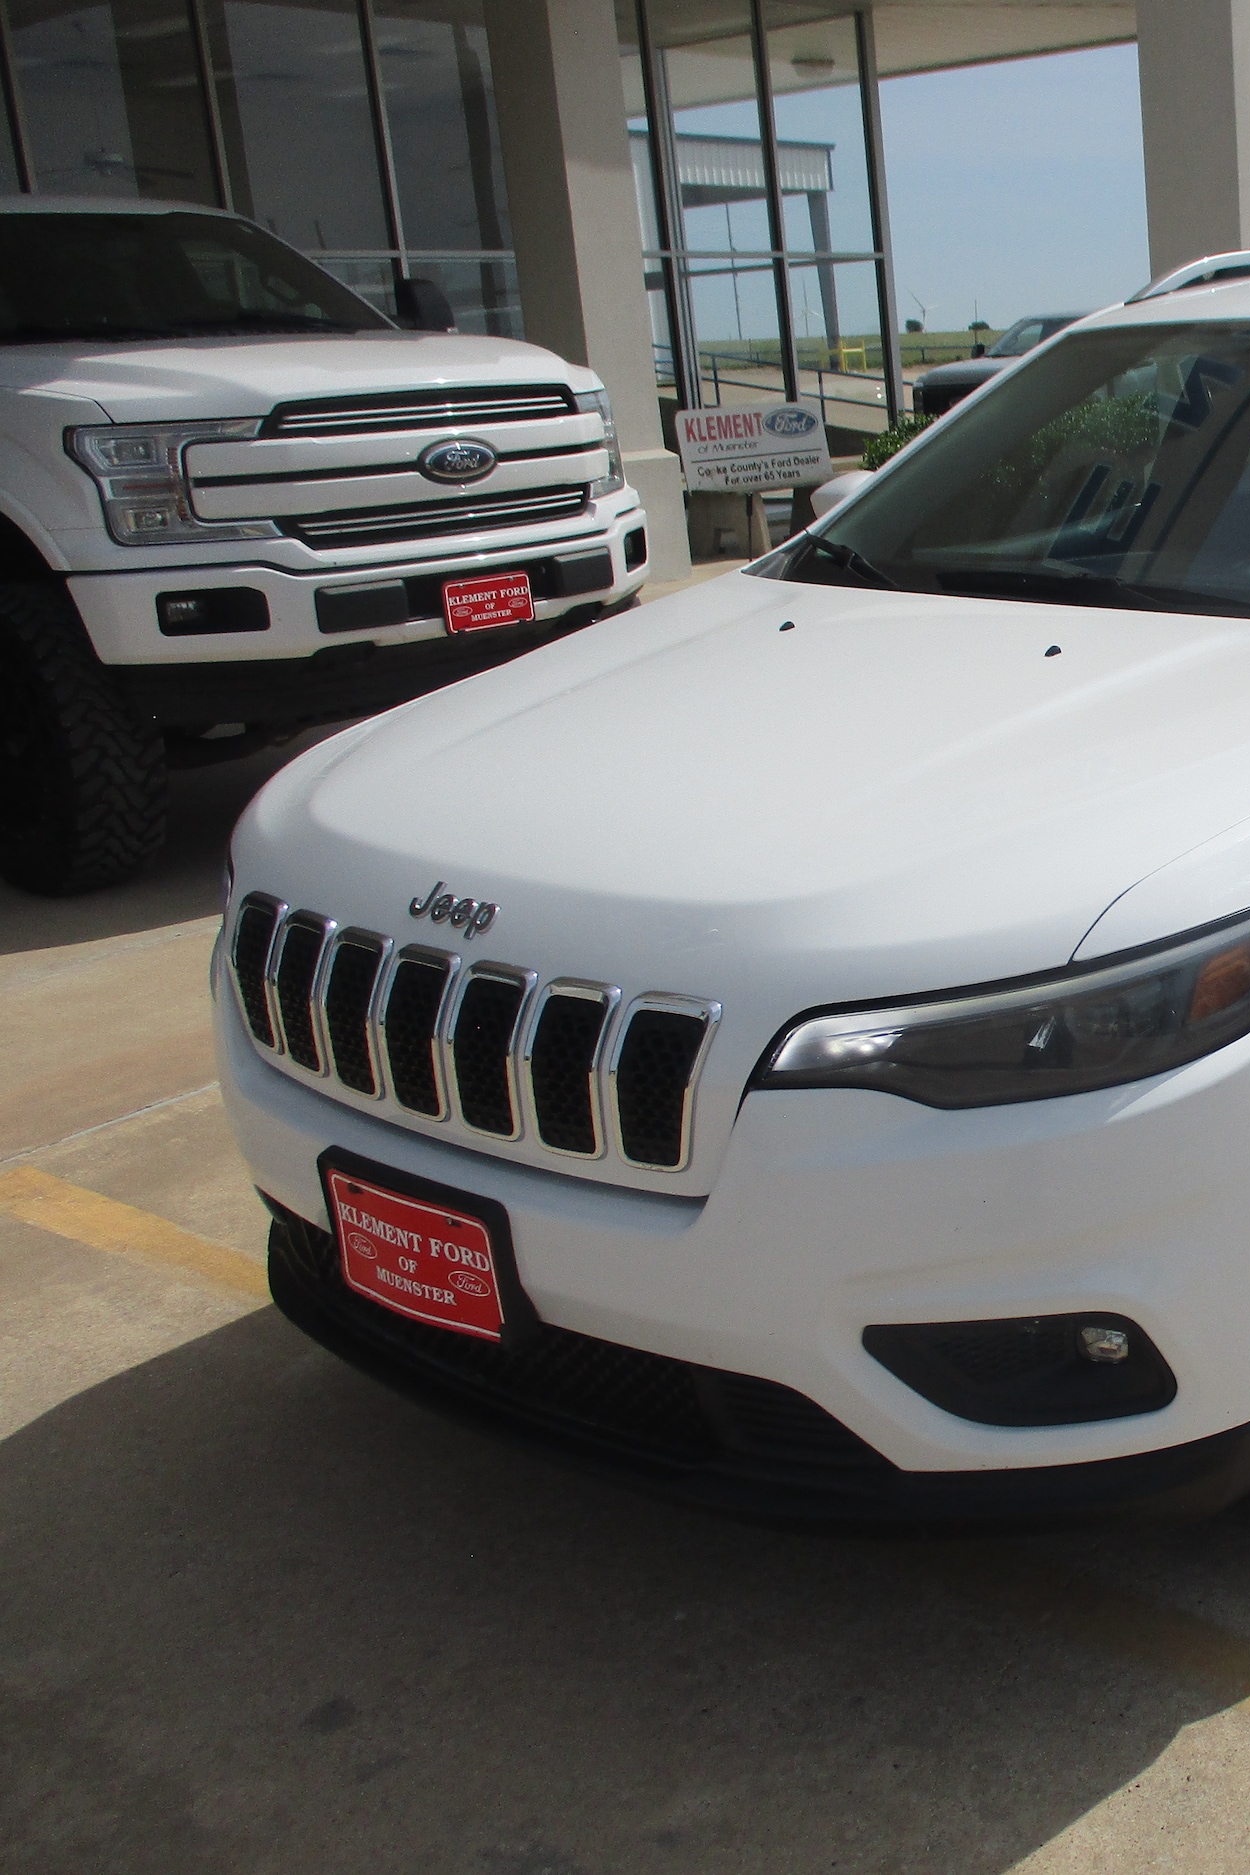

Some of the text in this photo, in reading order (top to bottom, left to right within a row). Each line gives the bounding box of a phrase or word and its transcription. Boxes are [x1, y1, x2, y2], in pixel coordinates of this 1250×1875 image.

[684, 412, 763, 443] KLEMENT
[774, 413, 807, 432] Ford
[730, 460, 769, 473] County's
[771, 458, 792, 468] Ford
[794, 455, 820, 466] Dealer
[725, 469, 801, 485] For over 65 Years
[448, 586, 528, 606] KLEMENT FORD
[471, 609, 512, 622] MUENSTER
[485, 602, 496, 610] OF
[409, 881, 501, 940] Jeep
[338, 1202, 490, 1272] KLEMENT FORD
[398, 1255, 418, 1274] OF
[376, 1265, 457, 1306] MUENSTER
[456, 1274, 483, 1294] Ford
